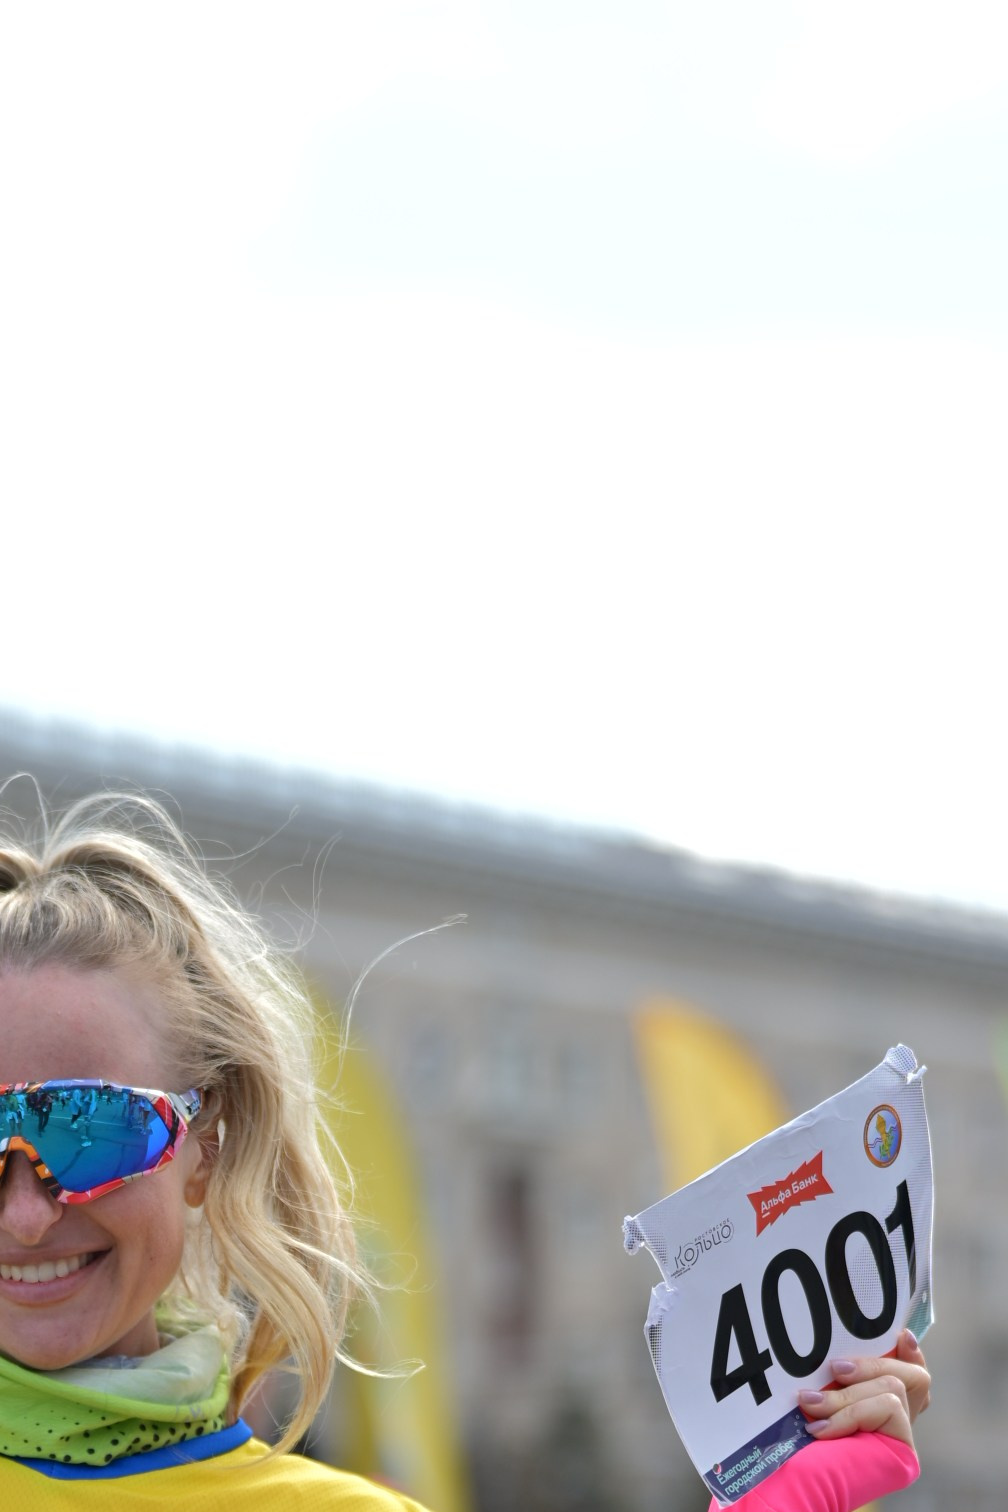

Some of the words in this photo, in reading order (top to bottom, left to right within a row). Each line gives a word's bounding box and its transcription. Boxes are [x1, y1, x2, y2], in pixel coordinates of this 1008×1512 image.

[761, 1189, 792, 1217] Альфа
[791, 1173, 819, 1194] Банк
[710, 1179, 917, 1406] 4001
[716, 1445, 762, 1485] Ежегодный
[724, 1458, 768, 1496] городской
